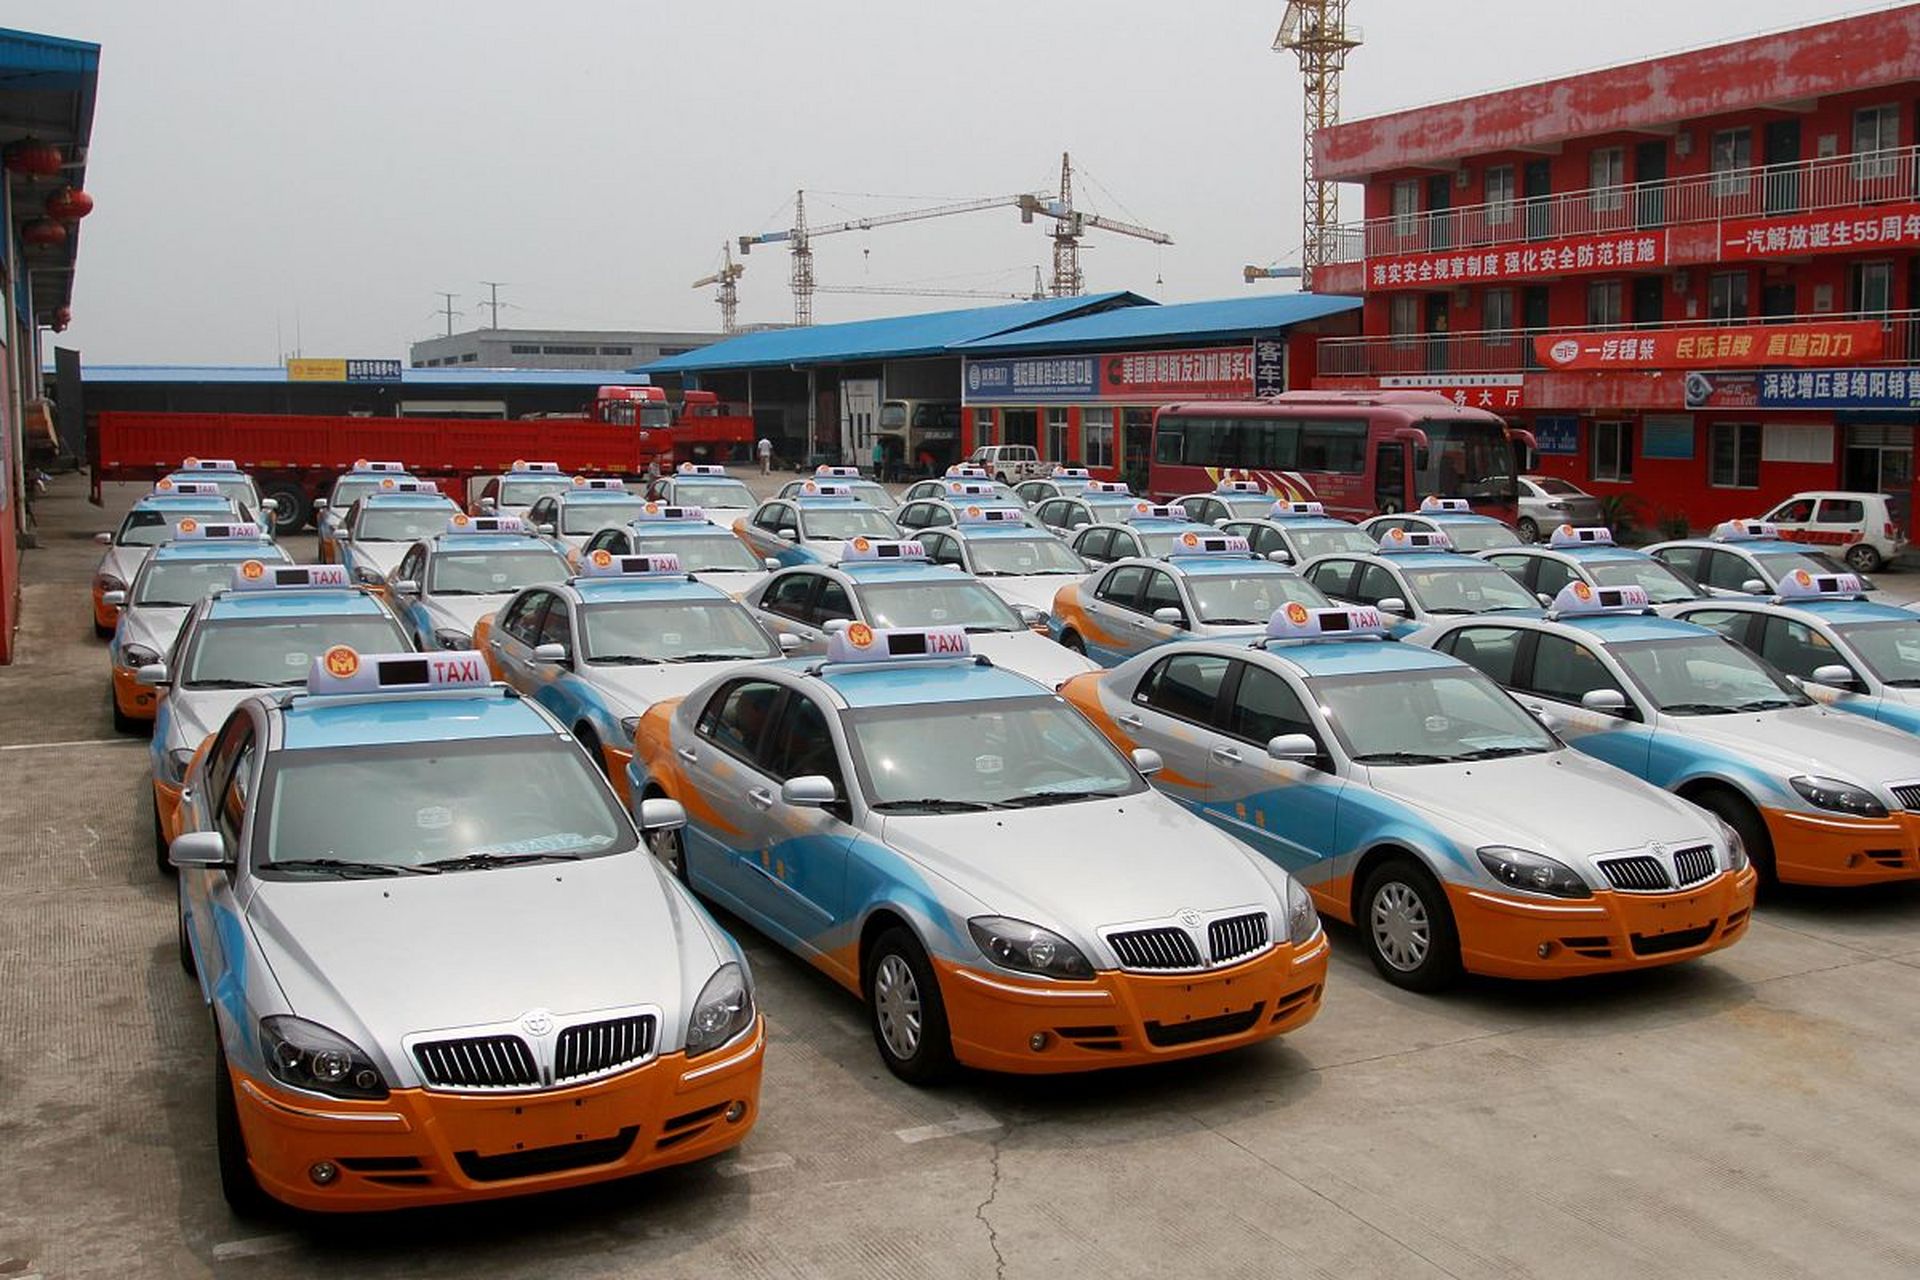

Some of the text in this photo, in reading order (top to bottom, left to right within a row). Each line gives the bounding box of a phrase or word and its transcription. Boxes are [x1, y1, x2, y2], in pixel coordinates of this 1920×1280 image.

[1726, 213, 1920, 253] 一汽解放诞生55周年
[1372, 238, 1656, 285] 落实安全规章制度 强化安全防范措施
[1584, 333, 1852, 361] 一汽锡柴 民族品牌 高端动力
[1432, 390, 1519, 406] 务大厅
[231, 527, 255, 537] TAXI
[499, 521, 520, 531] TAXI
[1227, 540, 1248, 551] TAXI
[1430, 534, 1448, 545] TAXI
[901, 546, 923, 556] TAXI
[652, 557, 678, 571] TAXI
[311, 571, 341, 585] TAXI
[1840, 578, 1860, 592] TAXI
[1622, 590, 1645, 605] TAXI
[1350, 611, 1380, 628] TAXI
[928, 634, 963, 653] TAXI
[434, 661, 479, 684] TAXI
